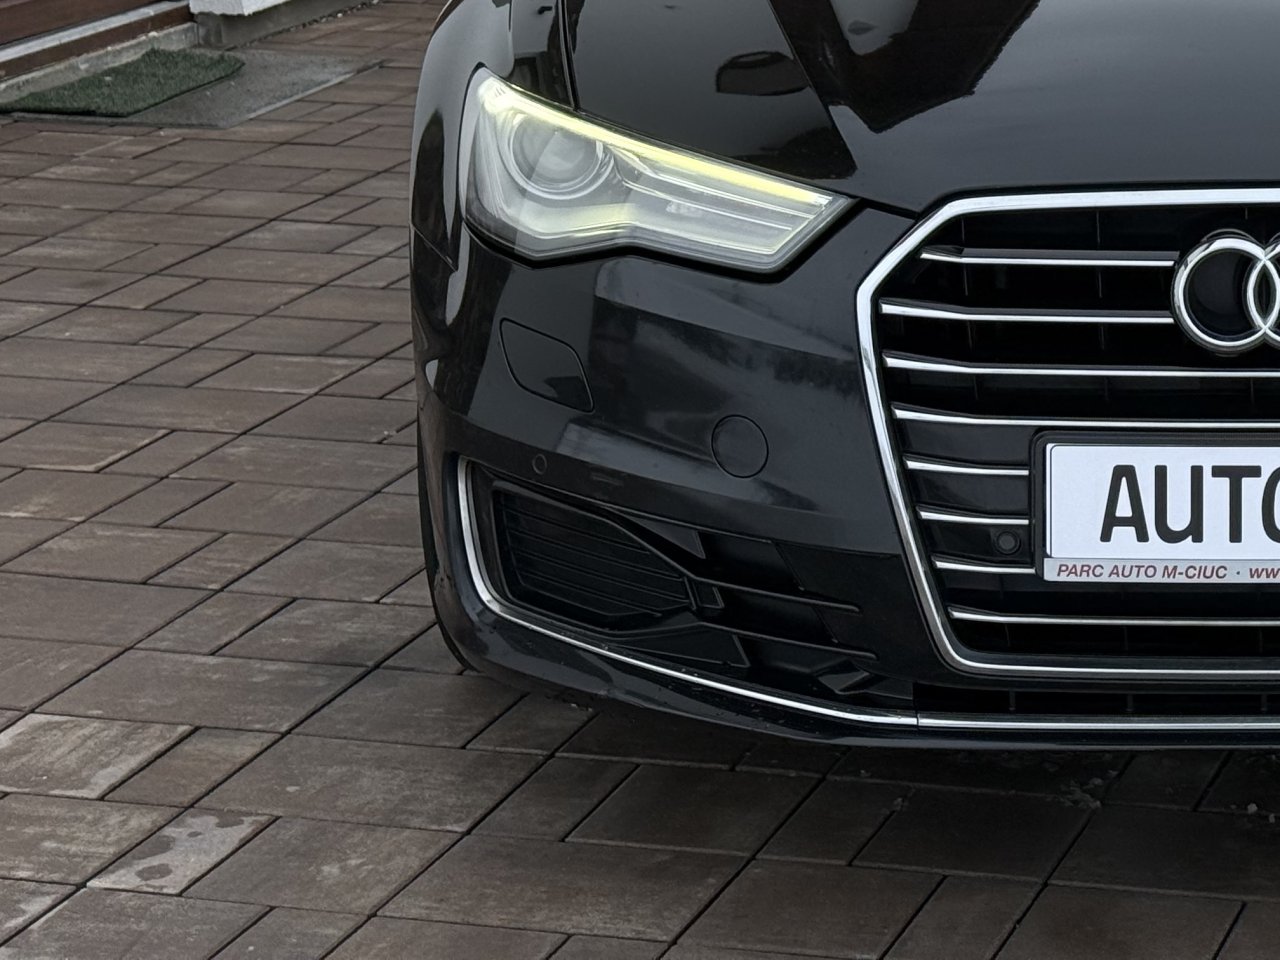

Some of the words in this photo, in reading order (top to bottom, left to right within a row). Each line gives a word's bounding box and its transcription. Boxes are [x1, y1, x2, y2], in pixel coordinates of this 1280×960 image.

[1056, 563, 1104, 578] PARC
[1107, 564, 1158, 579] AUTO
[1161, 564, 1228, 579] M-CIUC
